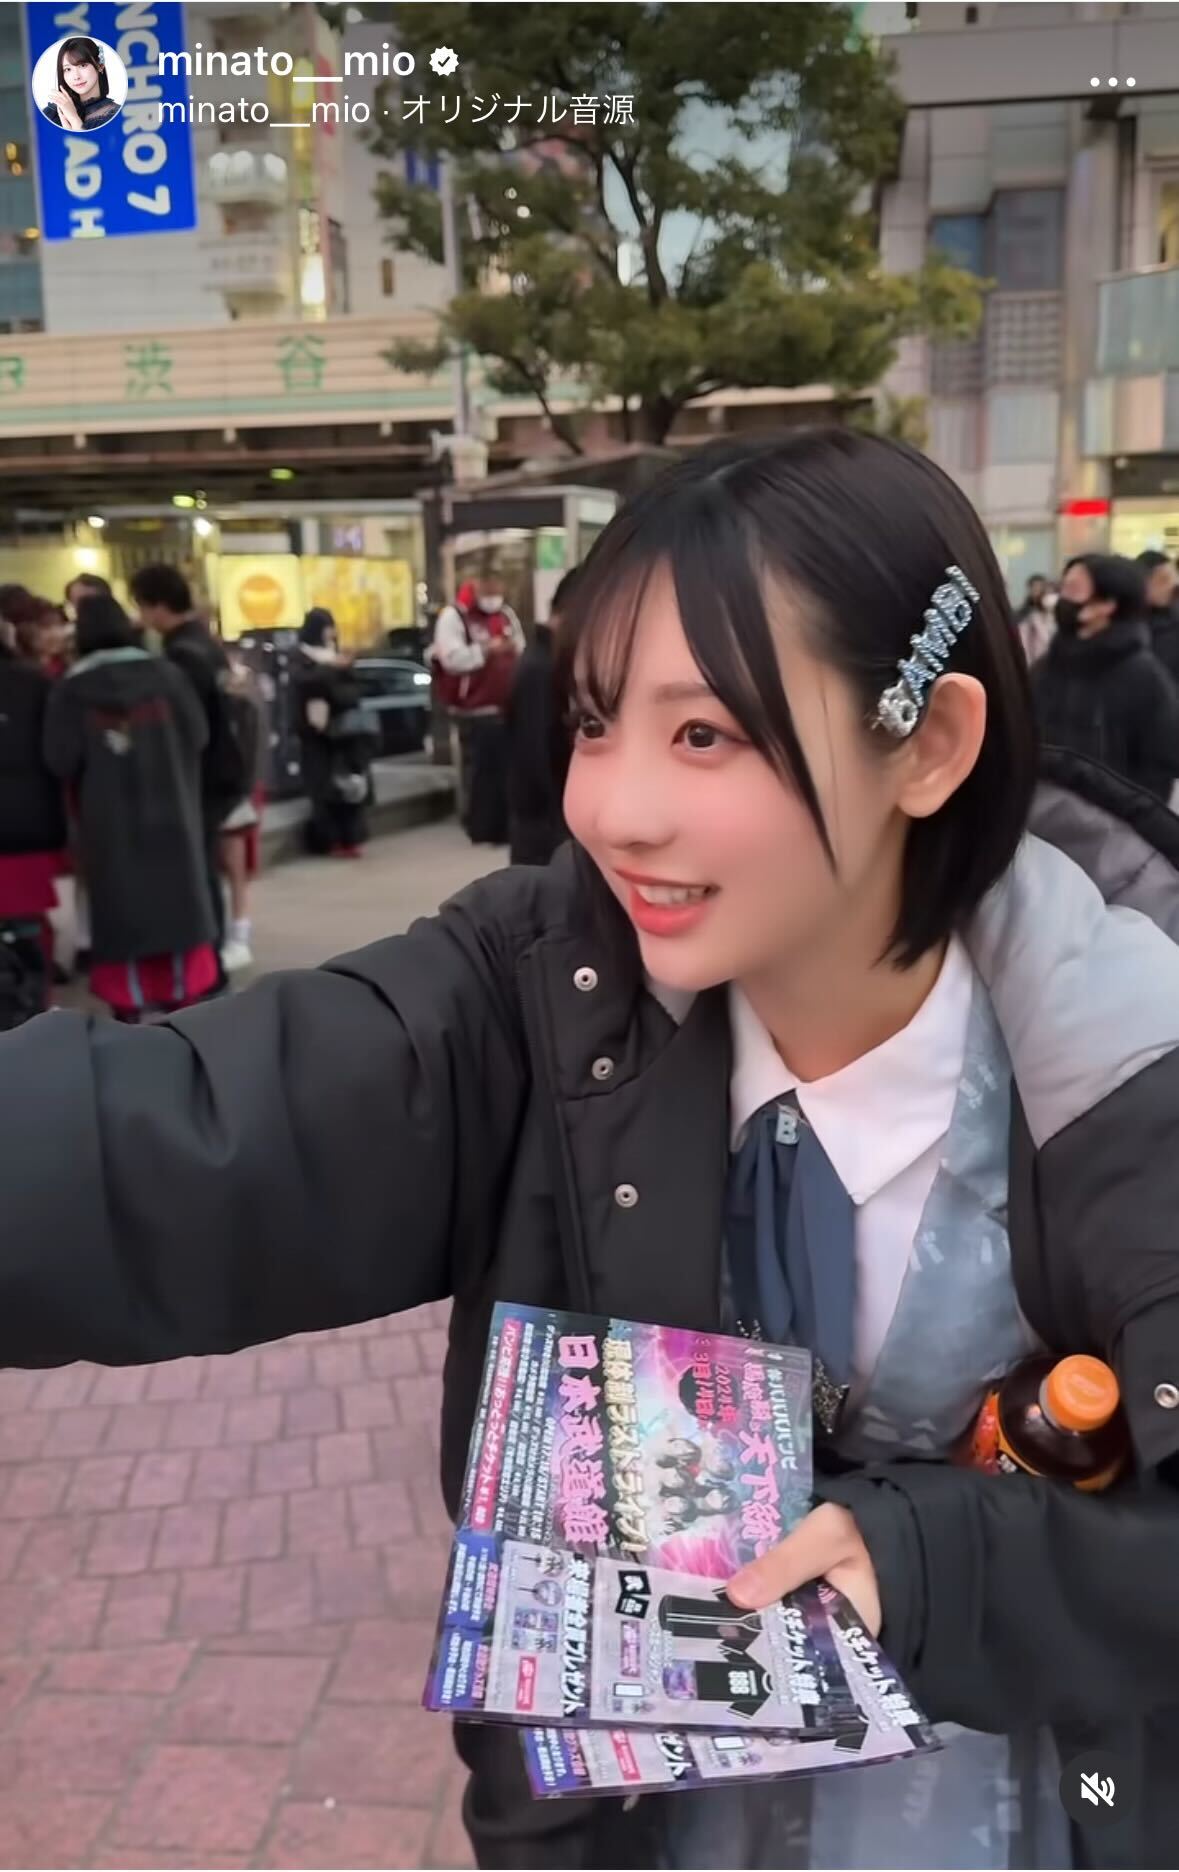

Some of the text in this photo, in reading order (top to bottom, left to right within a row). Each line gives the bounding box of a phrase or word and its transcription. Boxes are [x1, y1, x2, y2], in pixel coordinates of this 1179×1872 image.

[123, 333, 328, 396] 渋谷
[557, 1334, 607, 1544] 日本武道館
